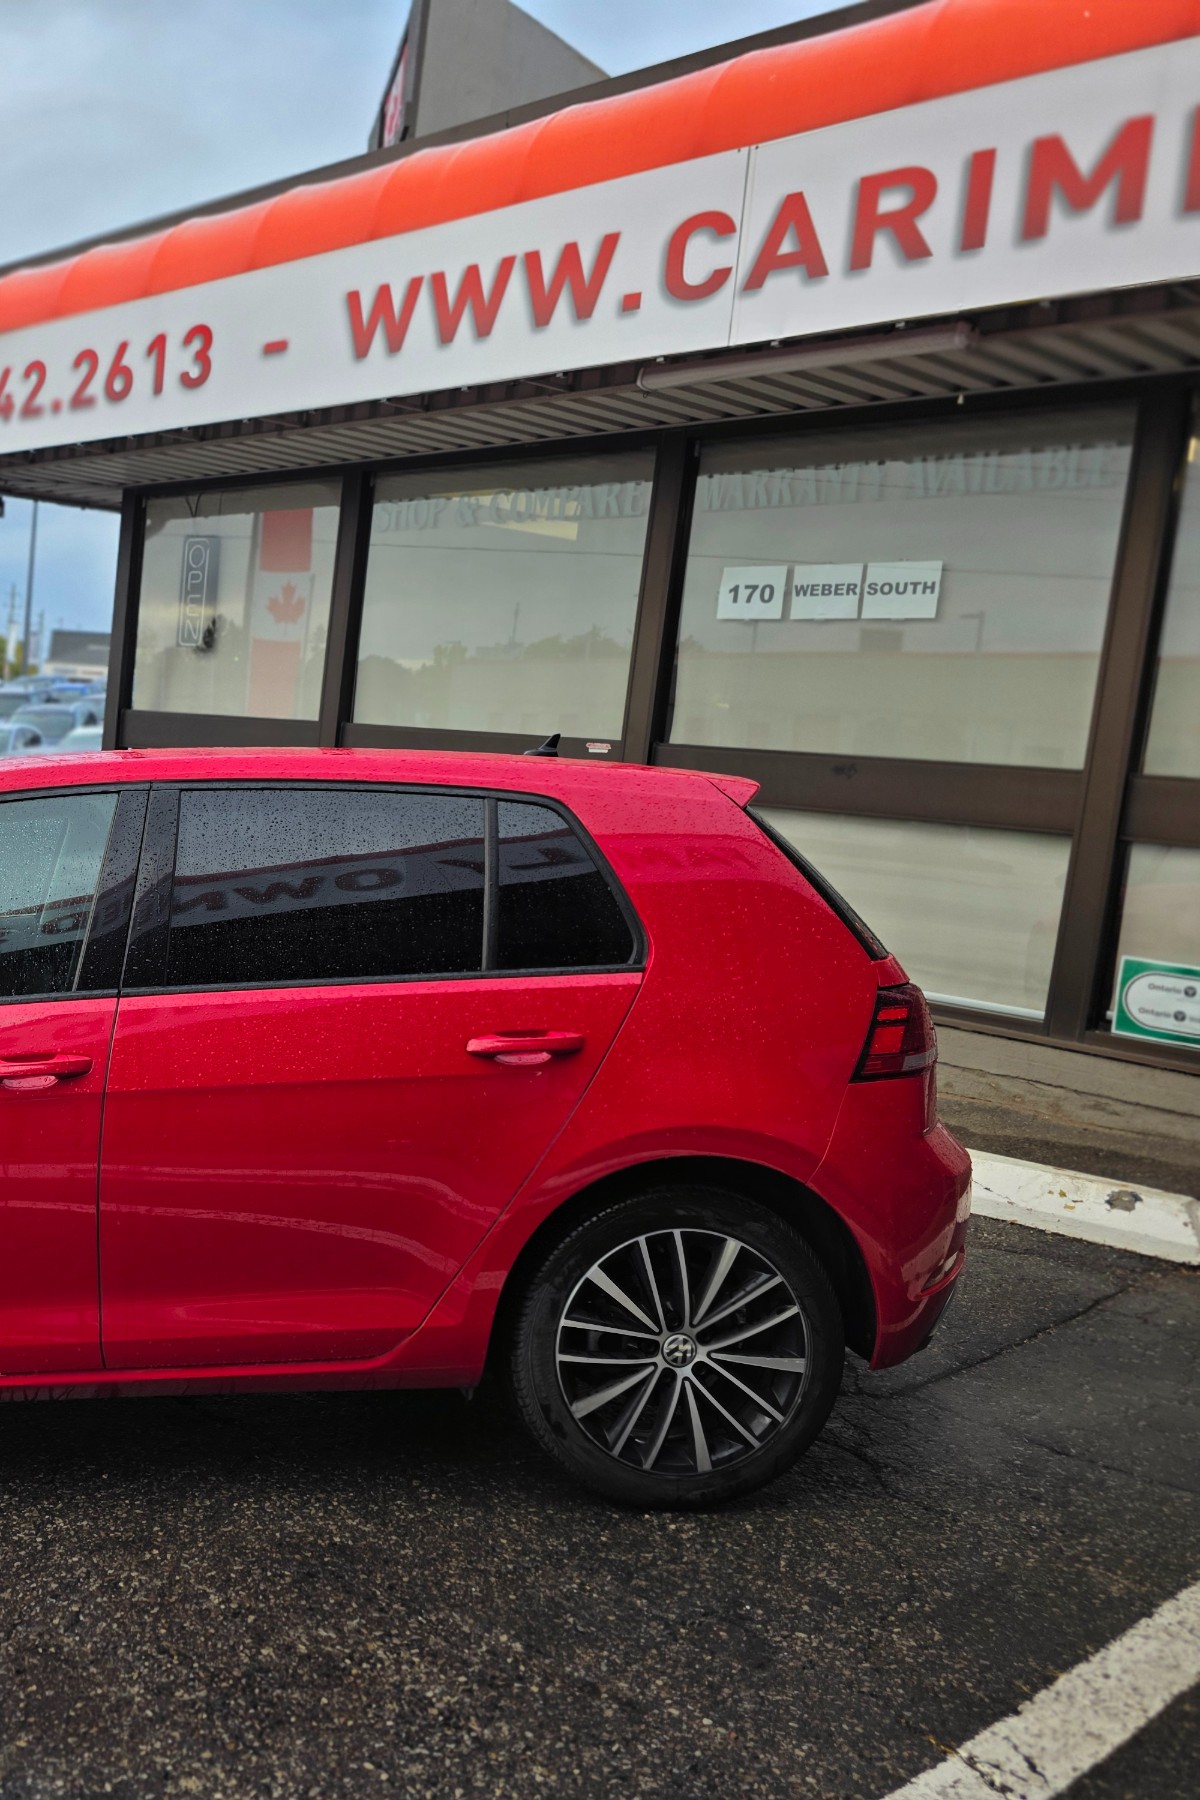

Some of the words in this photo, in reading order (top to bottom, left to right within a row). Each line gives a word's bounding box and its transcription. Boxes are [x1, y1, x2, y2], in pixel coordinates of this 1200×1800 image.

[346, 104, 1200, 360] WWW.CARIM
[185, 544, 206, 640] OPEN
[728, 584, 775, 604] 170
[794, 583, 858, 597] WEBER
[866, 581, 936, 595] SOUTH
[1147, 982, 1182, 995] Ontario
[1138, 1006, 1172, 1019] Ontario
